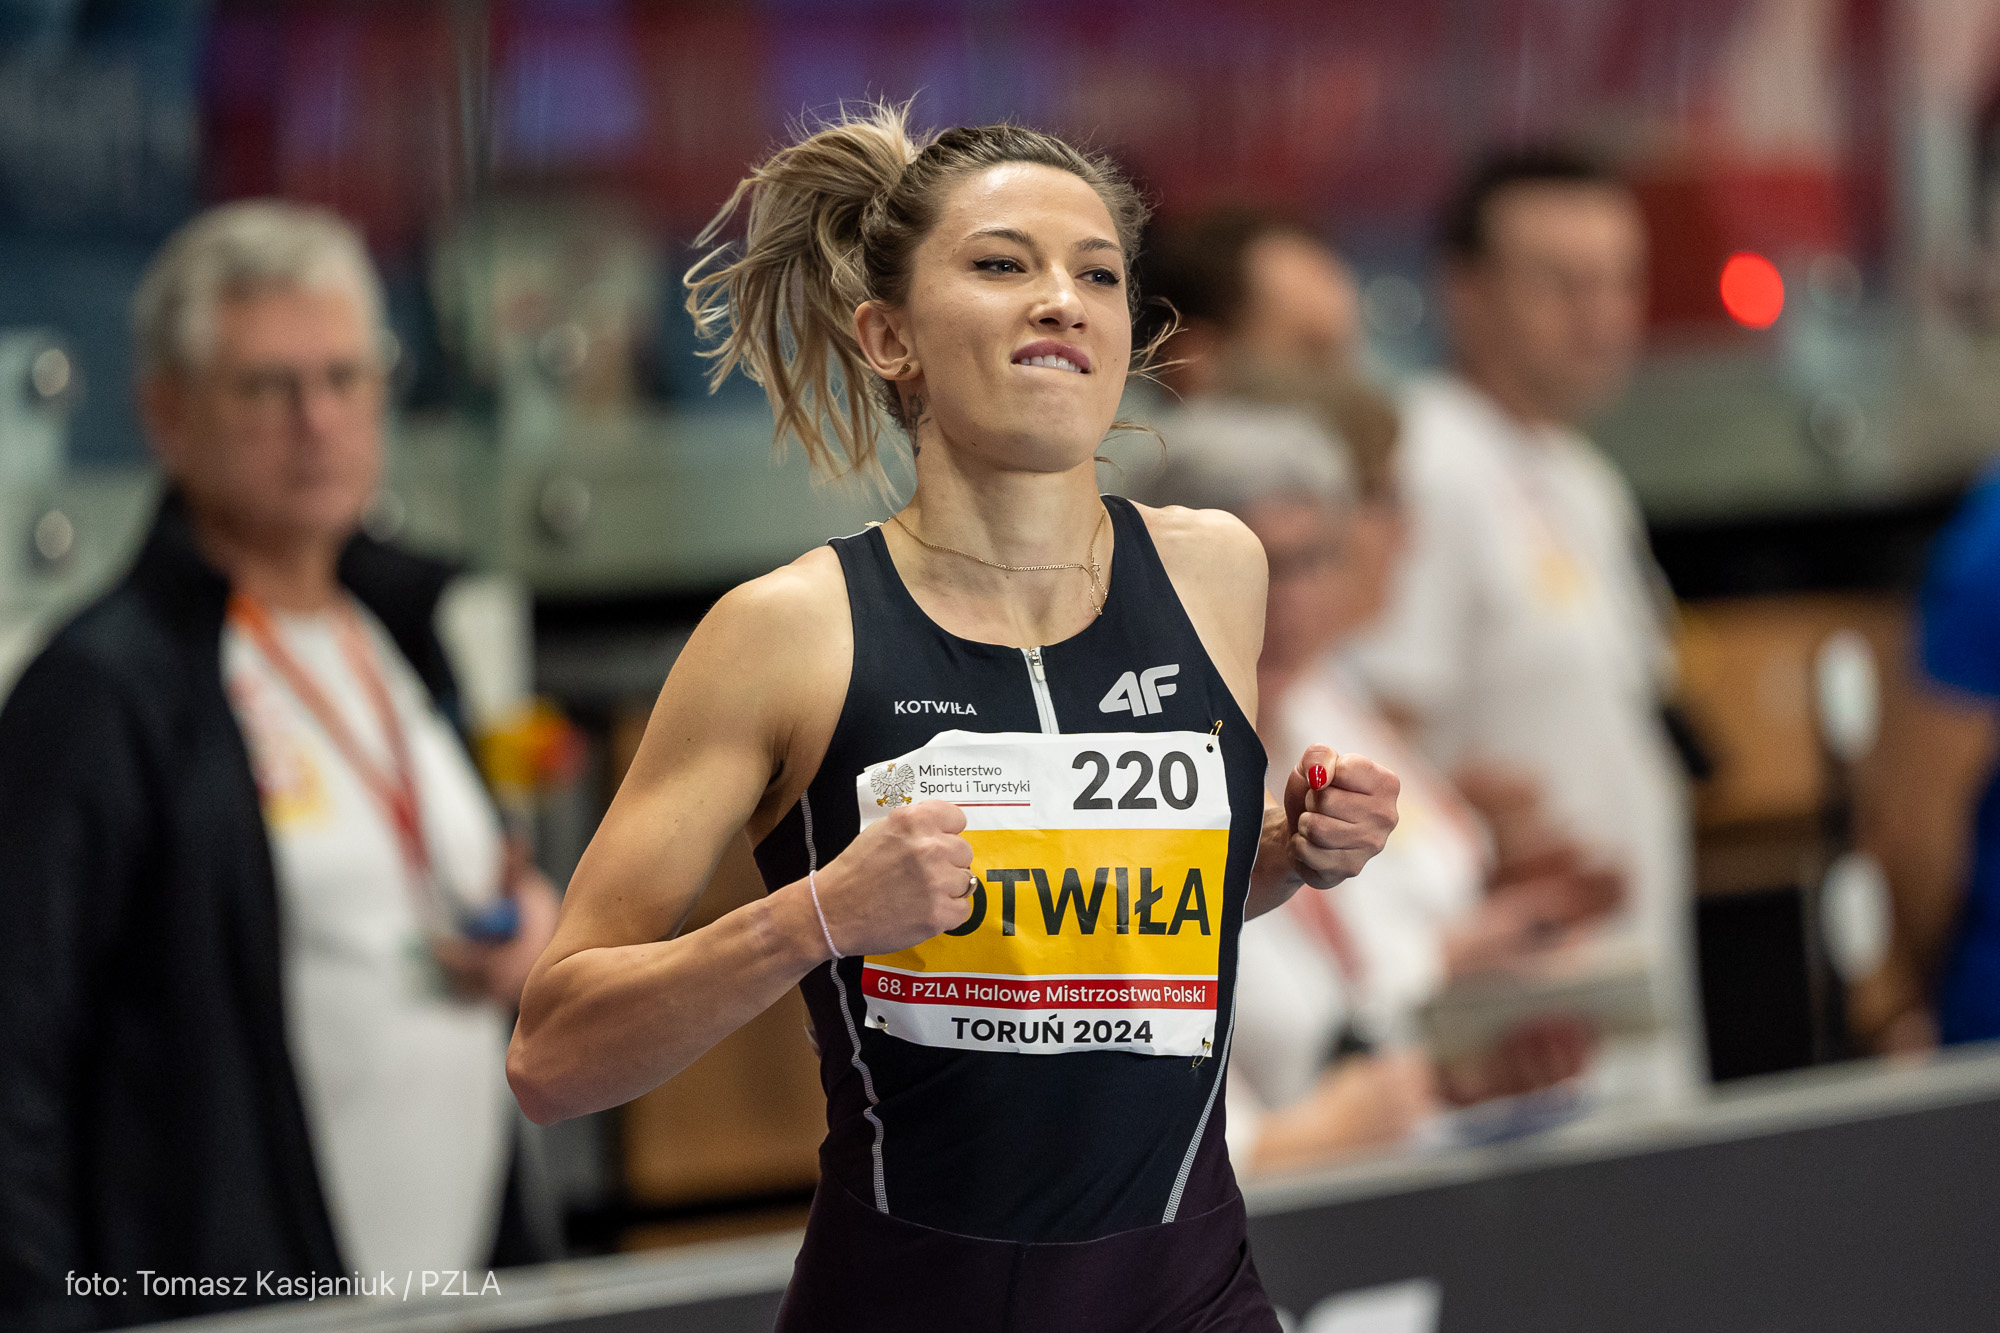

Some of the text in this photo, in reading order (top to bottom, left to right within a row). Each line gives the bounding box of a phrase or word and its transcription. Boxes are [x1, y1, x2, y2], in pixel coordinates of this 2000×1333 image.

[894, 700, 977, 716] KOTWIŁA
[919, 764, 1002, 777] Ministerstwo
[1071, 750, 1198, 810] 220
[920, 779, 1031, 794] Sportu i Turystyki
[877, 976, 1206, 1003] 68. PZLA Halowe Mistrzostwa Polski
[951, 1013, 1153, 1044] TORUŃ 2024
